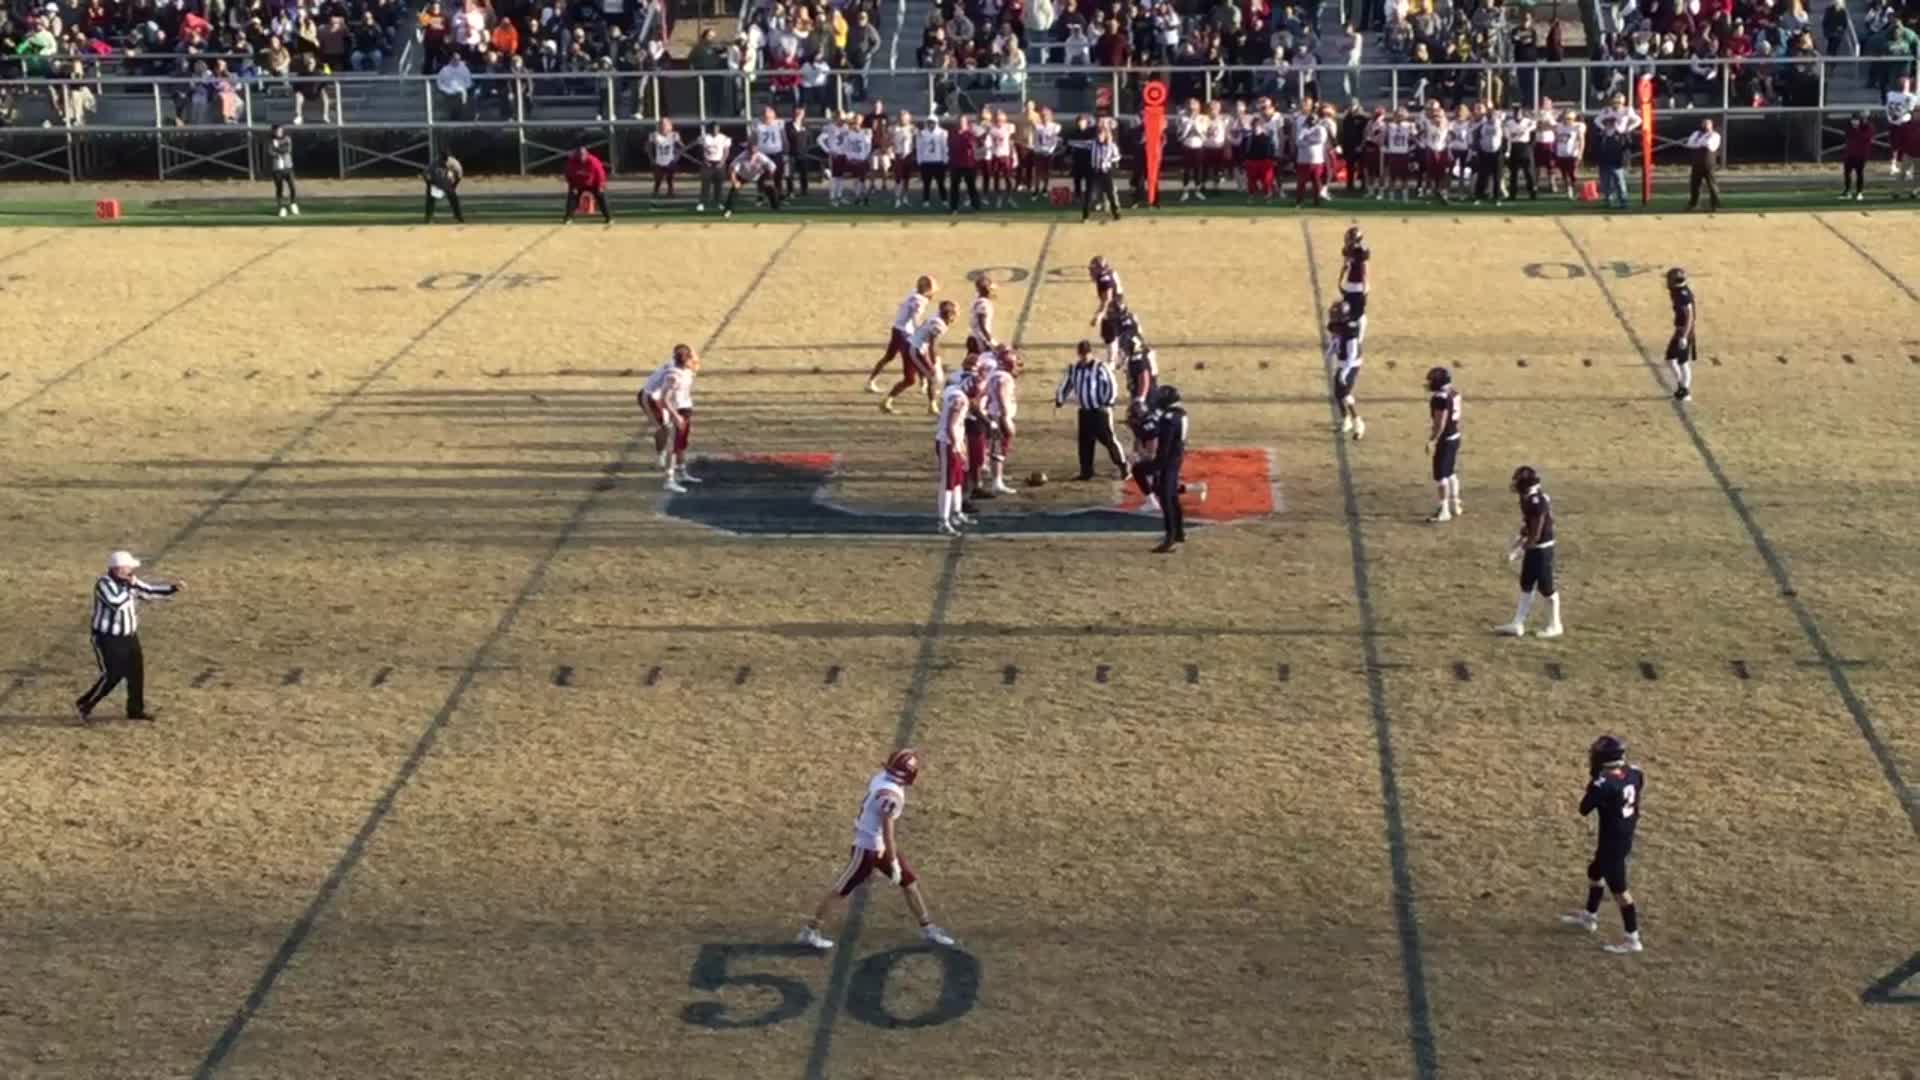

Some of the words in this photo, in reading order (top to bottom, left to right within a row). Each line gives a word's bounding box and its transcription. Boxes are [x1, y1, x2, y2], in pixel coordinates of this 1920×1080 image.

[96, 200, 115, 218] 30
[1622, 784, 1636, 818] 2
[681, 943, 980, 1028] 50
